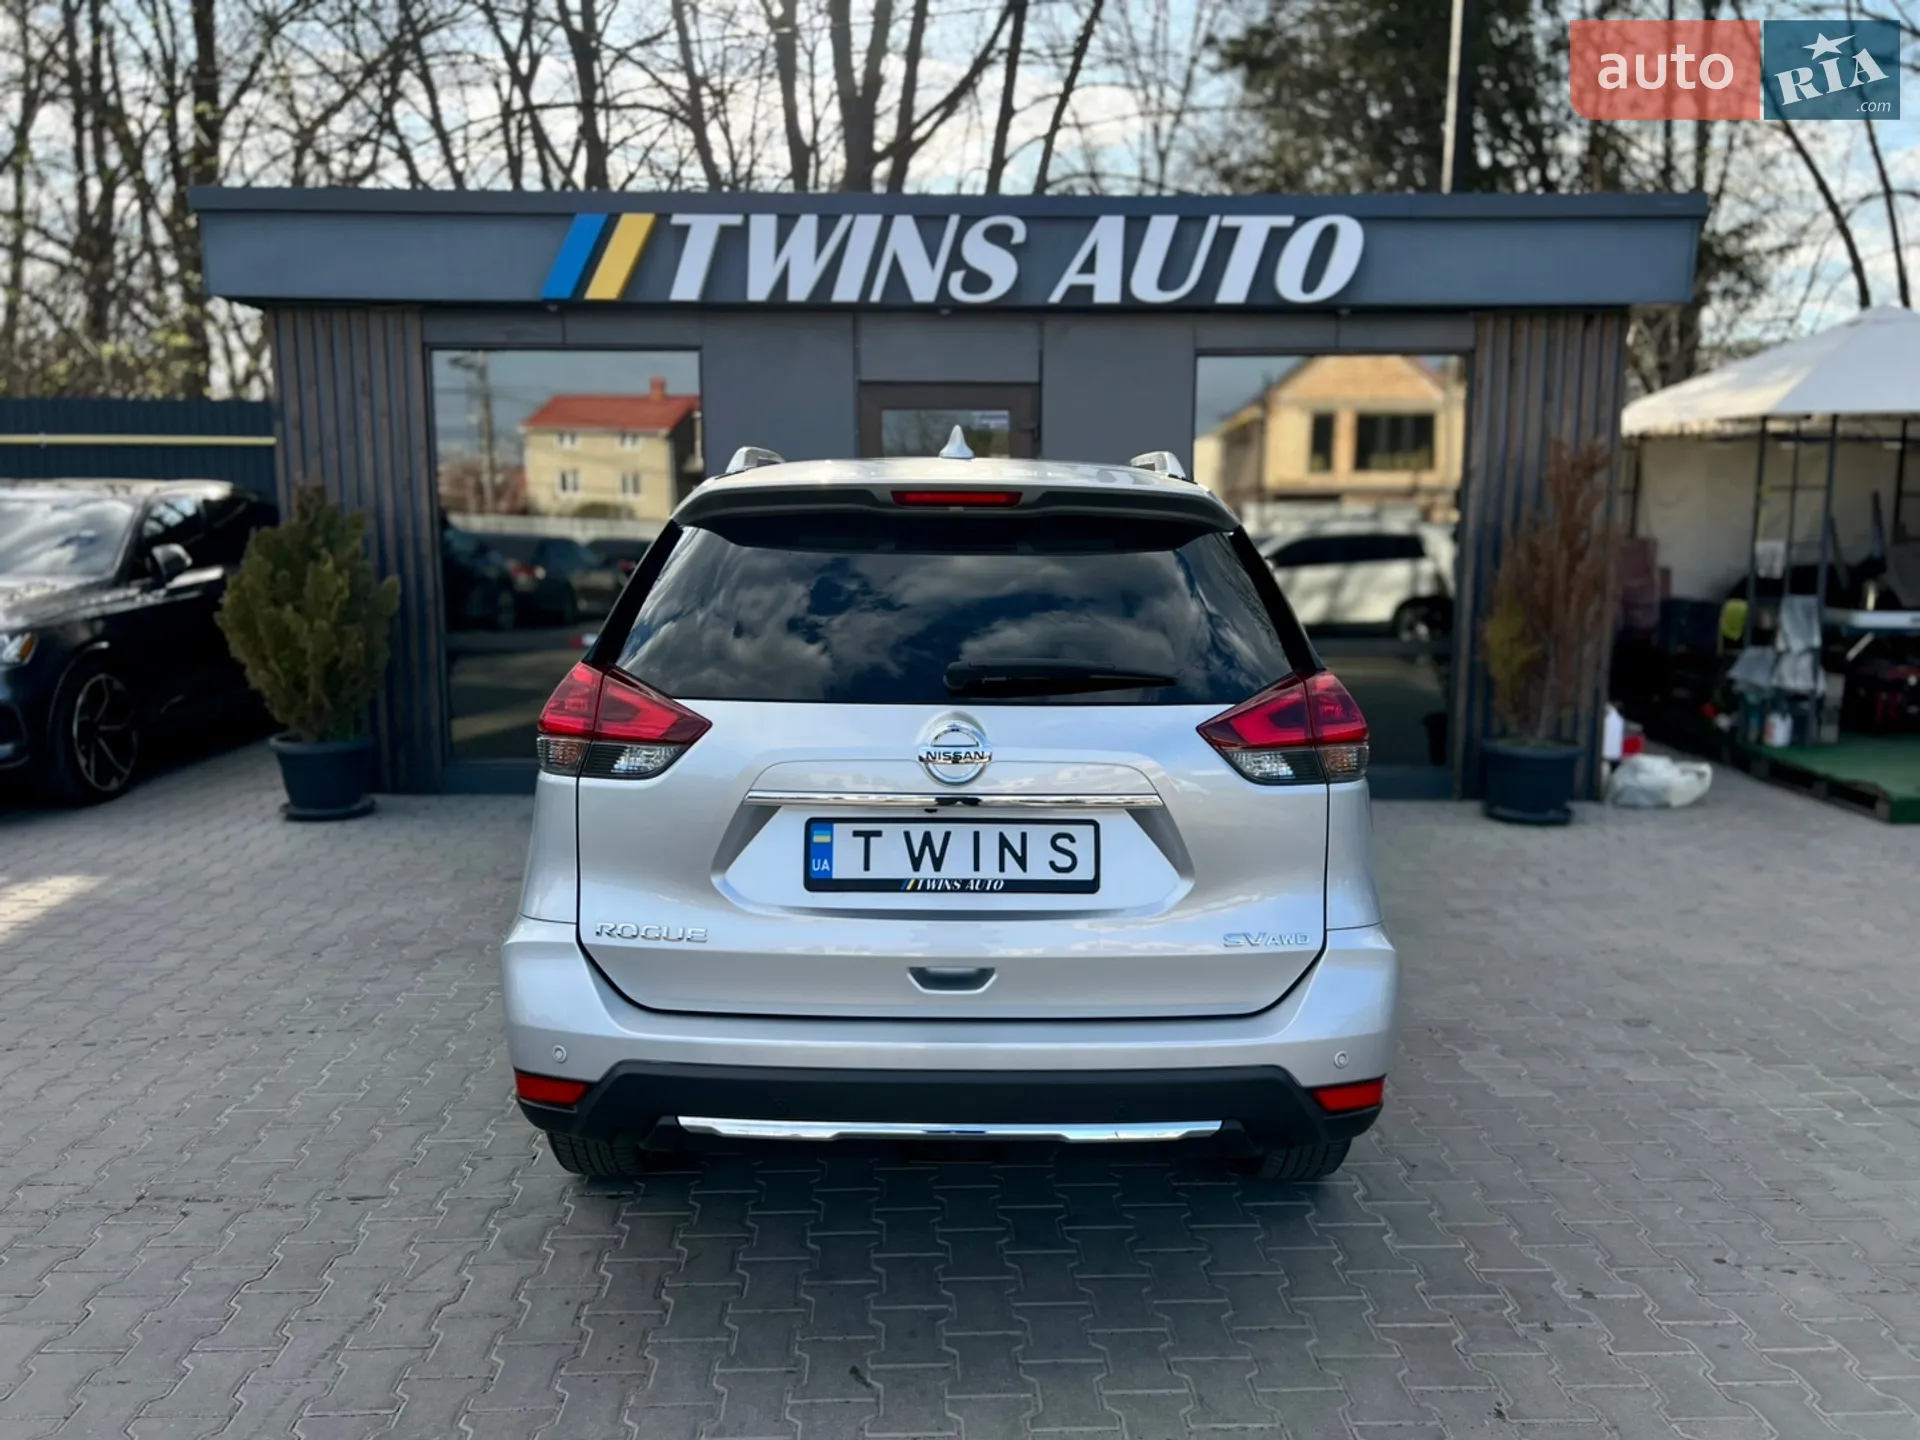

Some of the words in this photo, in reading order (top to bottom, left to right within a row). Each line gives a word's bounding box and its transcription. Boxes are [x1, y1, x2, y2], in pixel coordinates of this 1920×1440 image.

[668, 213, 1027, 304] TWINS
[1048, 214, 1364, 304] AUTO
[926, 750, 985, 762] NISSAN
[811, 858, 831, 872] UA
[915, 879, 962, 891] TWINS
[965, 879, 1005, 892] AUTO
[595, 921, 708, 943] ROGUE
